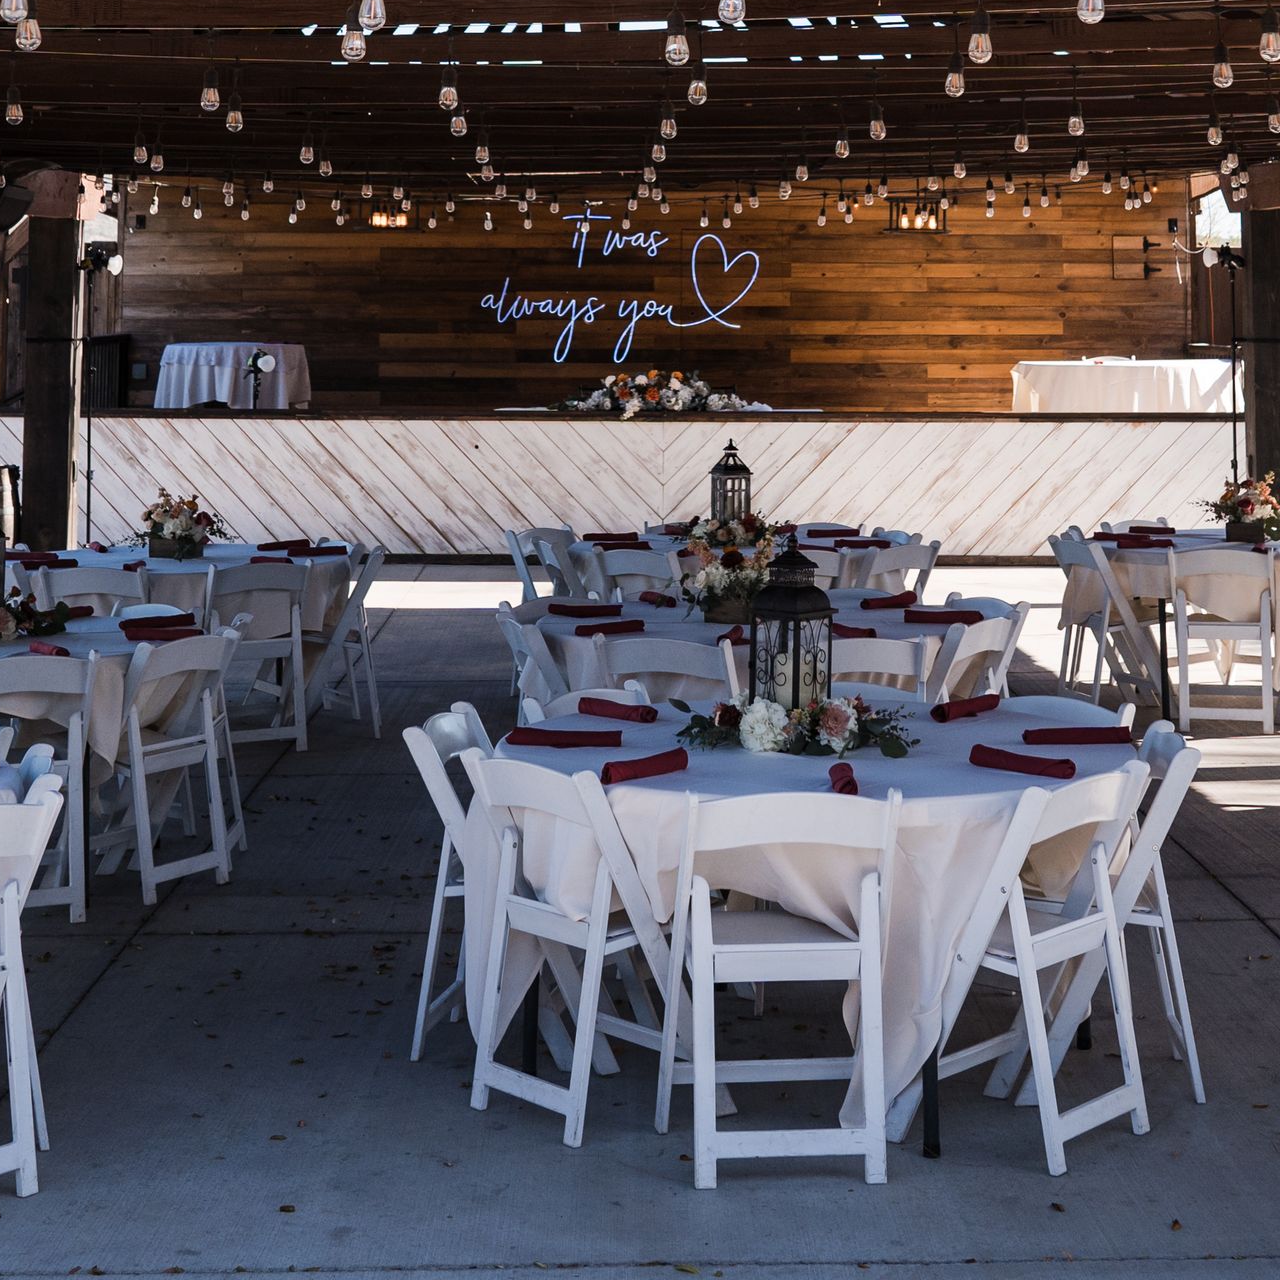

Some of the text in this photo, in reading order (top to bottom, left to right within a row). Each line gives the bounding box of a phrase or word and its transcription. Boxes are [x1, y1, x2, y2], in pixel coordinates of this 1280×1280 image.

[602, 229, 669, 257] was
[480, 277, 675, 363] always you
